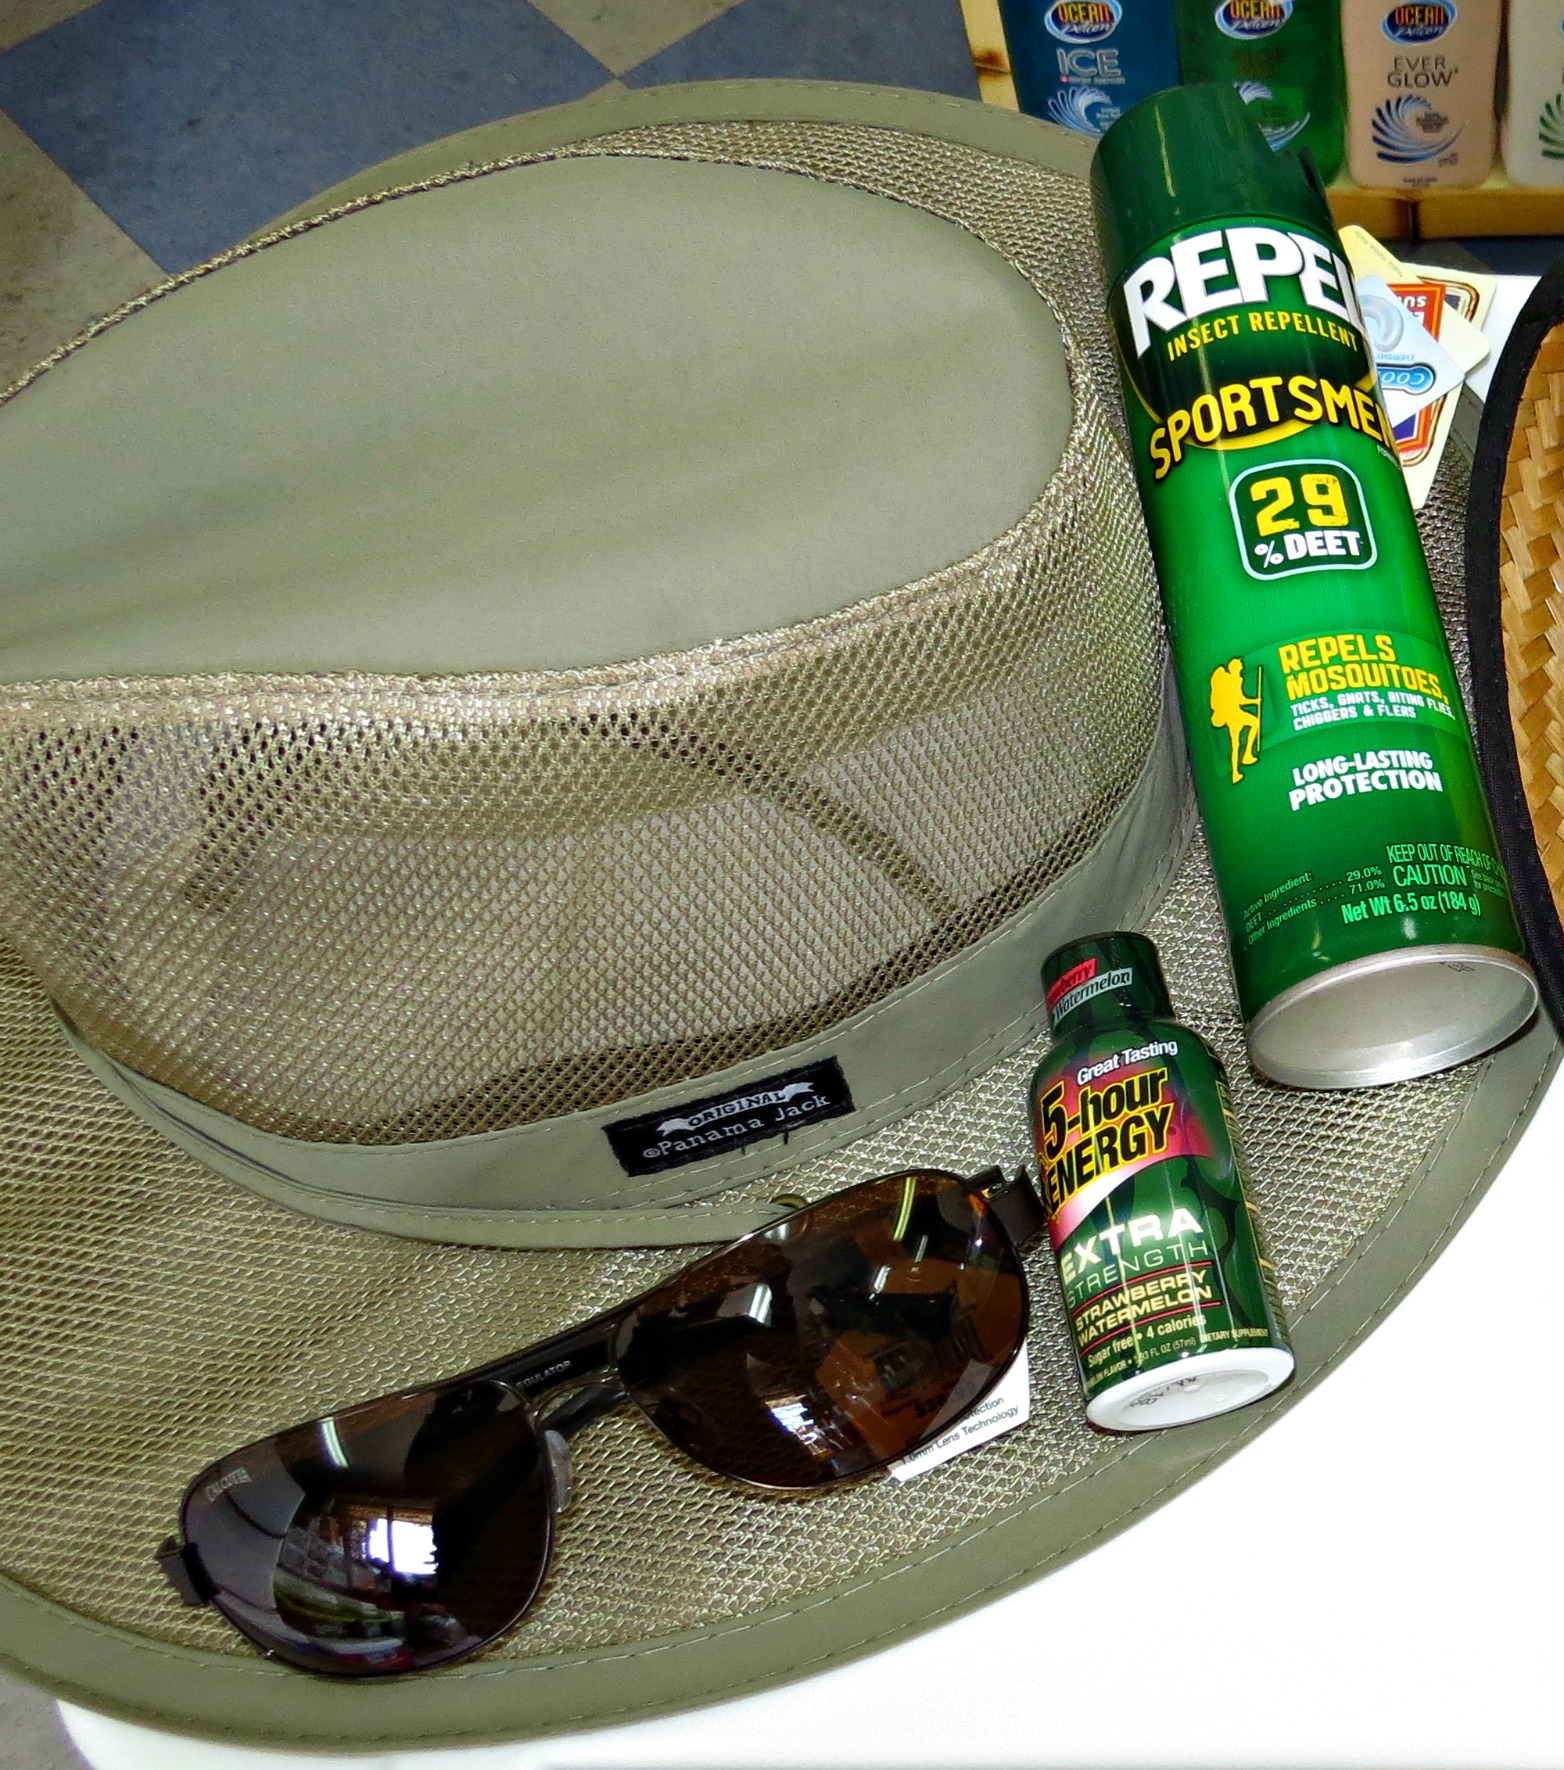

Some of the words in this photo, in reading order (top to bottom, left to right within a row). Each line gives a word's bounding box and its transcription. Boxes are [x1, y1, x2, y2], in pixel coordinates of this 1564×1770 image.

[1057, 1, 1112, 23] OCEAN
[1230, 0, 1281, 20] OCEAN
[1395, 4, 1445, 26] OCEAN
[1057, 48, 1122, 77] ICE
[1393, 54, 1446, 72] EVER
[1167, 314, 1240, 362] INSECT
[1250, 311, 1359, 353] REPELLENT
[1378, 371, 1425, 385] COO
[1249, 473, 1349, 537] 29
[1278, 634, 1396, 674] REPELS
[1286, 662, 1449, 705] MOSQUITOES,
[1290, 697, 1334, 717] TICKS,
[1337, 691, 1385, 706] GNATS,
[1388, 691, 1425, 707] BITING
[1293, 707, 1358, 730] CHIGGERS
[1363, 704, 1374, 716] &
[1292, 750, 1433, 786] LONG-LASTING
[1288, 769, 1443, 811] PROTECTION
[1386, 844, 1415, 863] KEEP
[1417, 844, 1438, 861] OUT
[1440, 844, 1453, 861] OF
[1454, 845, 1482, 868] REACH
[1393, 864, 1468, 886] CAUTION
[1245, 912, 1262, 932] DEET
[1346, 866, 1382, 882] 29.0%
[1266, 899, 1317, 930] Ingredients
[1349, 879, 1385, 895] 71.0%
[1341, 900, 1369, 924] Net
[1368, 895, 1393, 917] Wt
[1393, 891, 1419, 913] 6.5
[1420, 895, 1438, 911] oz
[1438, 890, 1468, 914] (184
[1468, 893, 1481, 917] g)
[1053, 971, 1131, 1020] Watermelon
[1077, 1056, 1120, 1085] Great
[1121, 1040, 1178, 1066] Tasting
[688, 1090, 785, 1128] ORIGINAL
[774, 1094, 831, 1122] Jack
[1041, 1067, 1168, 1161] 5-hour
[1046, 1103, 1174, 1215] ENERGY
[1060, 1207, 1204, 1287] EXTRA
[1067, 1240, 1209, 1308] STRENGTH
[1075, 1270, 1207, 1331] STRAWBERRY
[1078, 1285, 1213, 1347] WATERMELON
[1088, 1346, 1111, 1368] Sugar
[1112, 1335, 1134, 1353] free
[1146, 1325, 1155, 1339] 4
[1157, 1314, 1207, 1336] calories
[1150, 1347, 1160, 1358] FL
[1160, 1342, 1171, 1353] OZ
[516, 1360, 572, 1388] EGULATOR
[935, 1432, 960, 1449] Lens
[961, 1406, 1019, 1436] Technology
